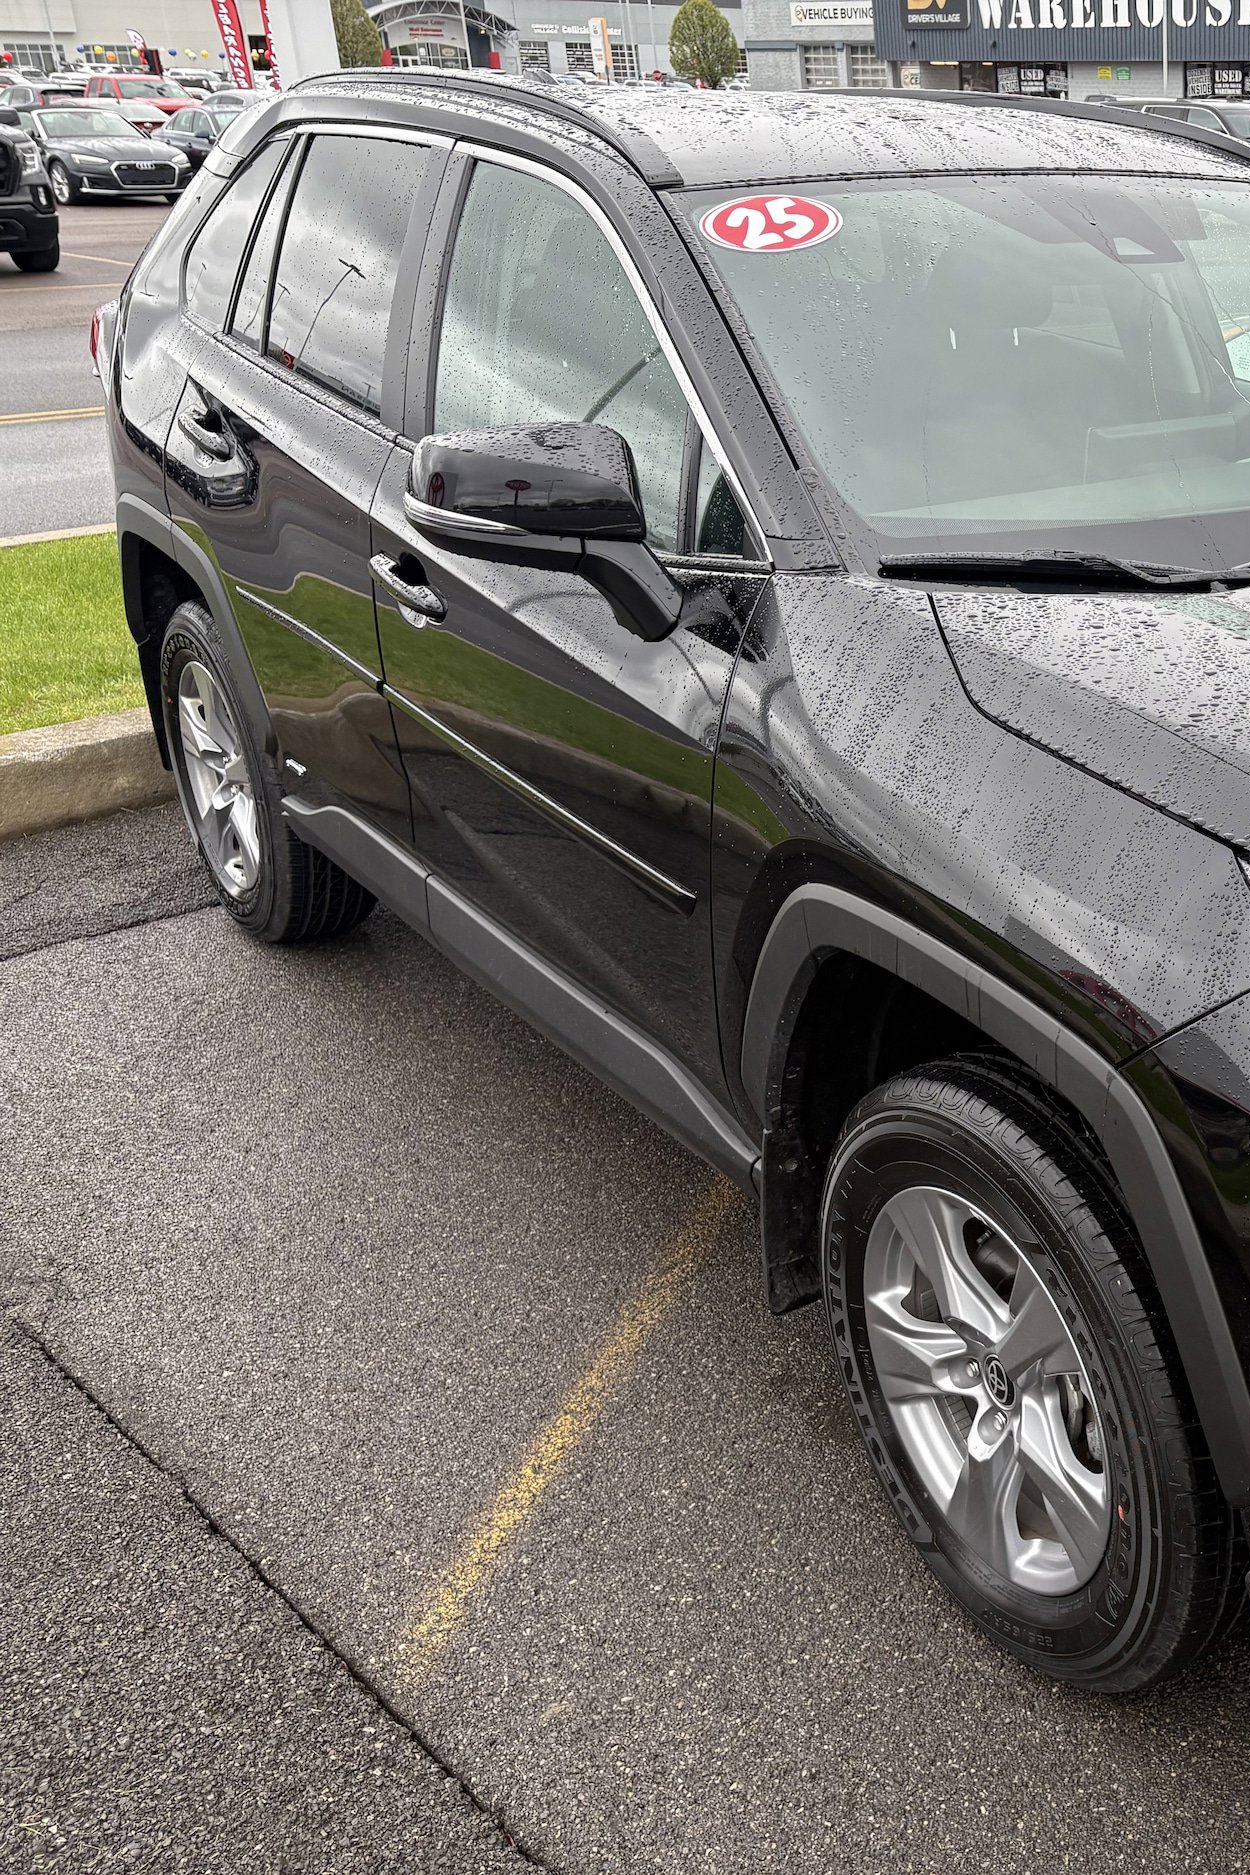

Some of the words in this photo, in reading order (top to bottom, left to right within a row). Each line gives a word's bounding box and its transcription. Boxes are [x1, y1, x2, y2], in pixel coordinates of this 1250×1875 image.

[802, 8, 839, 20] VEHICLE
[934, 14, 960, 23] VILLAGE
[1020, 68, 1044, 80] USED
[1214, 69, 1242, 82] USED
[1188, 83, 1212, 96] INSIDE
[725, 197, 814, 249] 25
[828, 1208, 921, 1533] DESTINATION
